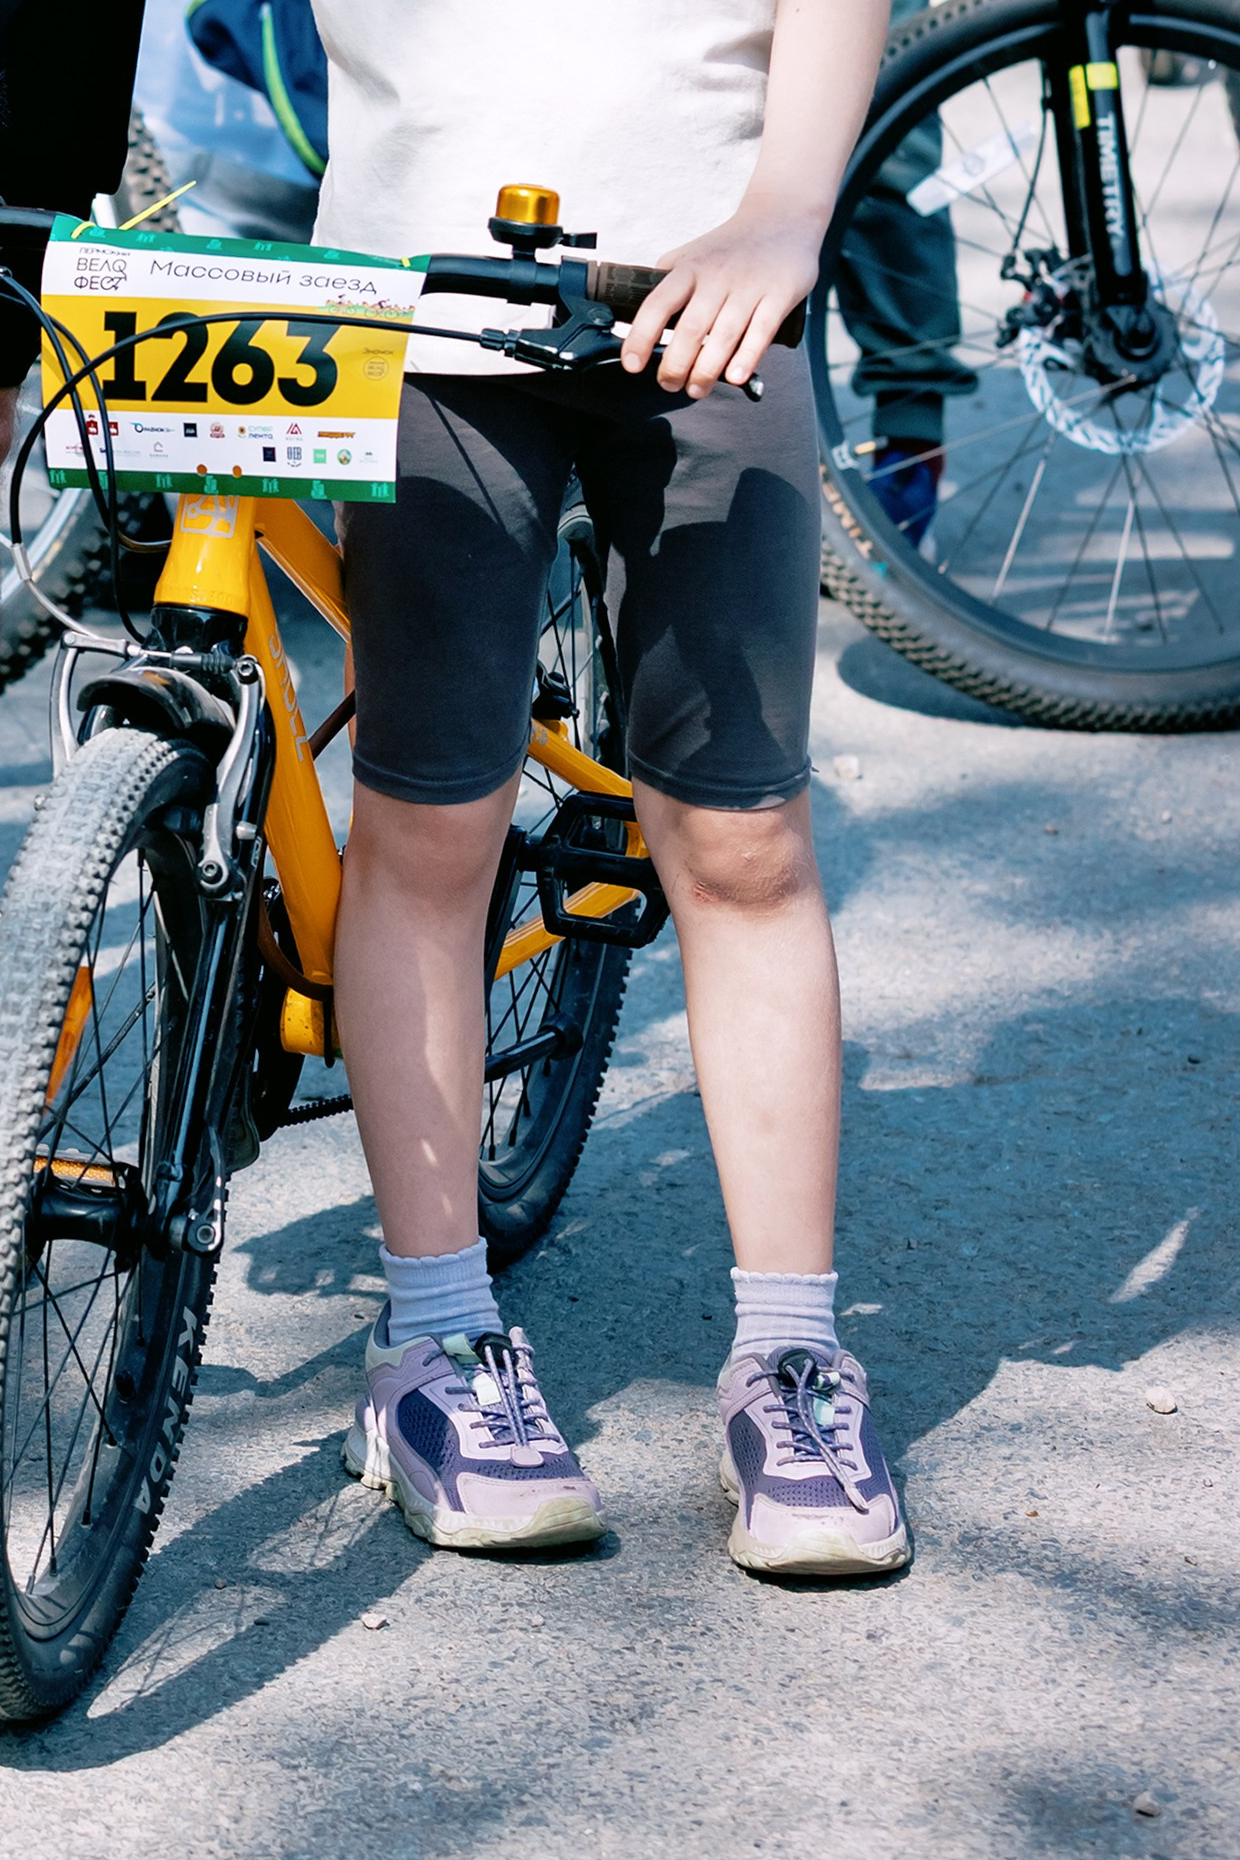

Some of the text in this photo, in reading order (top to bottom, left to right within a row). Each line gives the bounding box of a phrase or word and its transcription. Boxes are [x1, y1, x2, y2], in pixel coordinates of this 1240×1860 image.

[150, 259, 377, 295] Массовый заезд
[102, 311, 339, 406] 1263
[132, 1305, 198, 1515] KENDA
